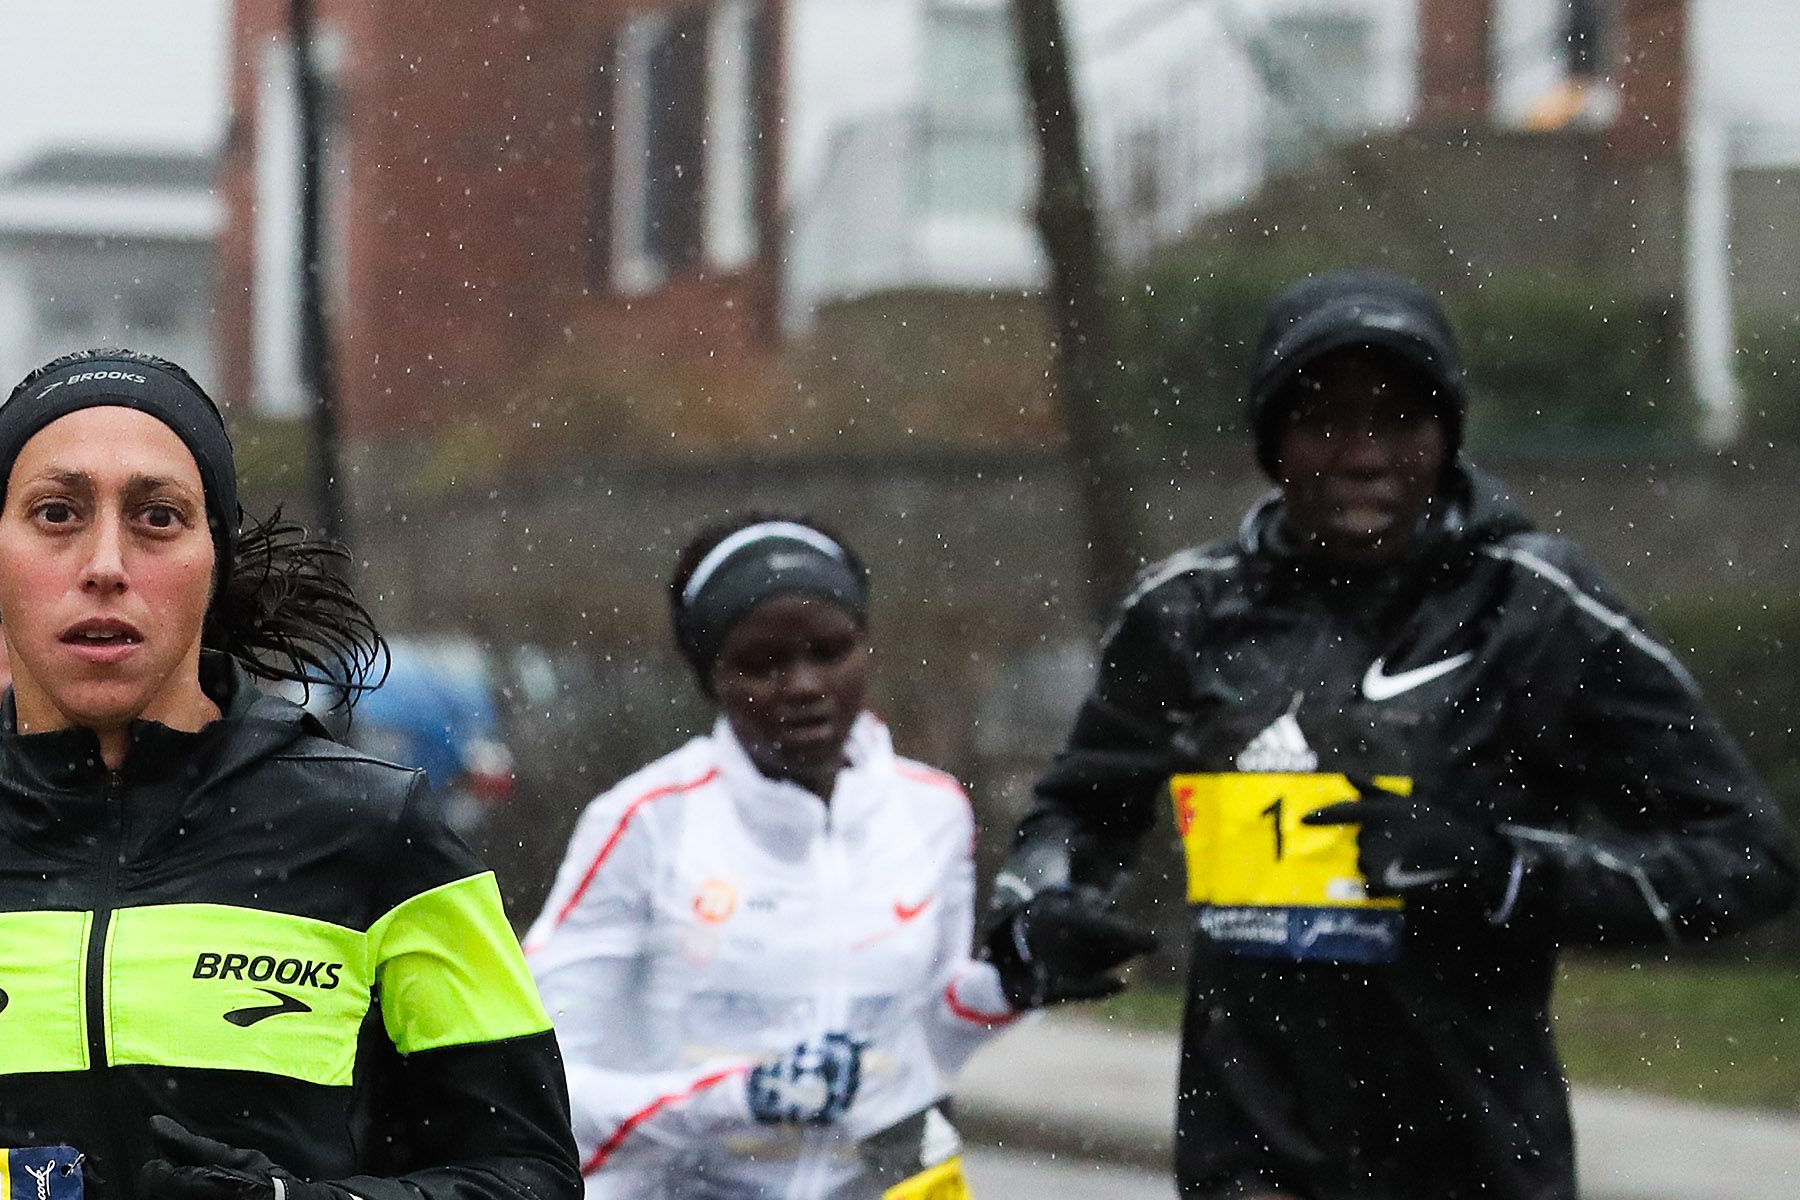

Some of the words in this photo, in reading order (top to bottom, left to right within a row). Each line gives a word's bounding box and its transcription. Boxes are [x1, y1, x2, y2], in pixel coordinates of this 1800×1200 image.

[67, 371, 147, 386] BROOKS
[1260, 797, 1283, 863] 1
[192, 952, 343, 990] BROOKS
